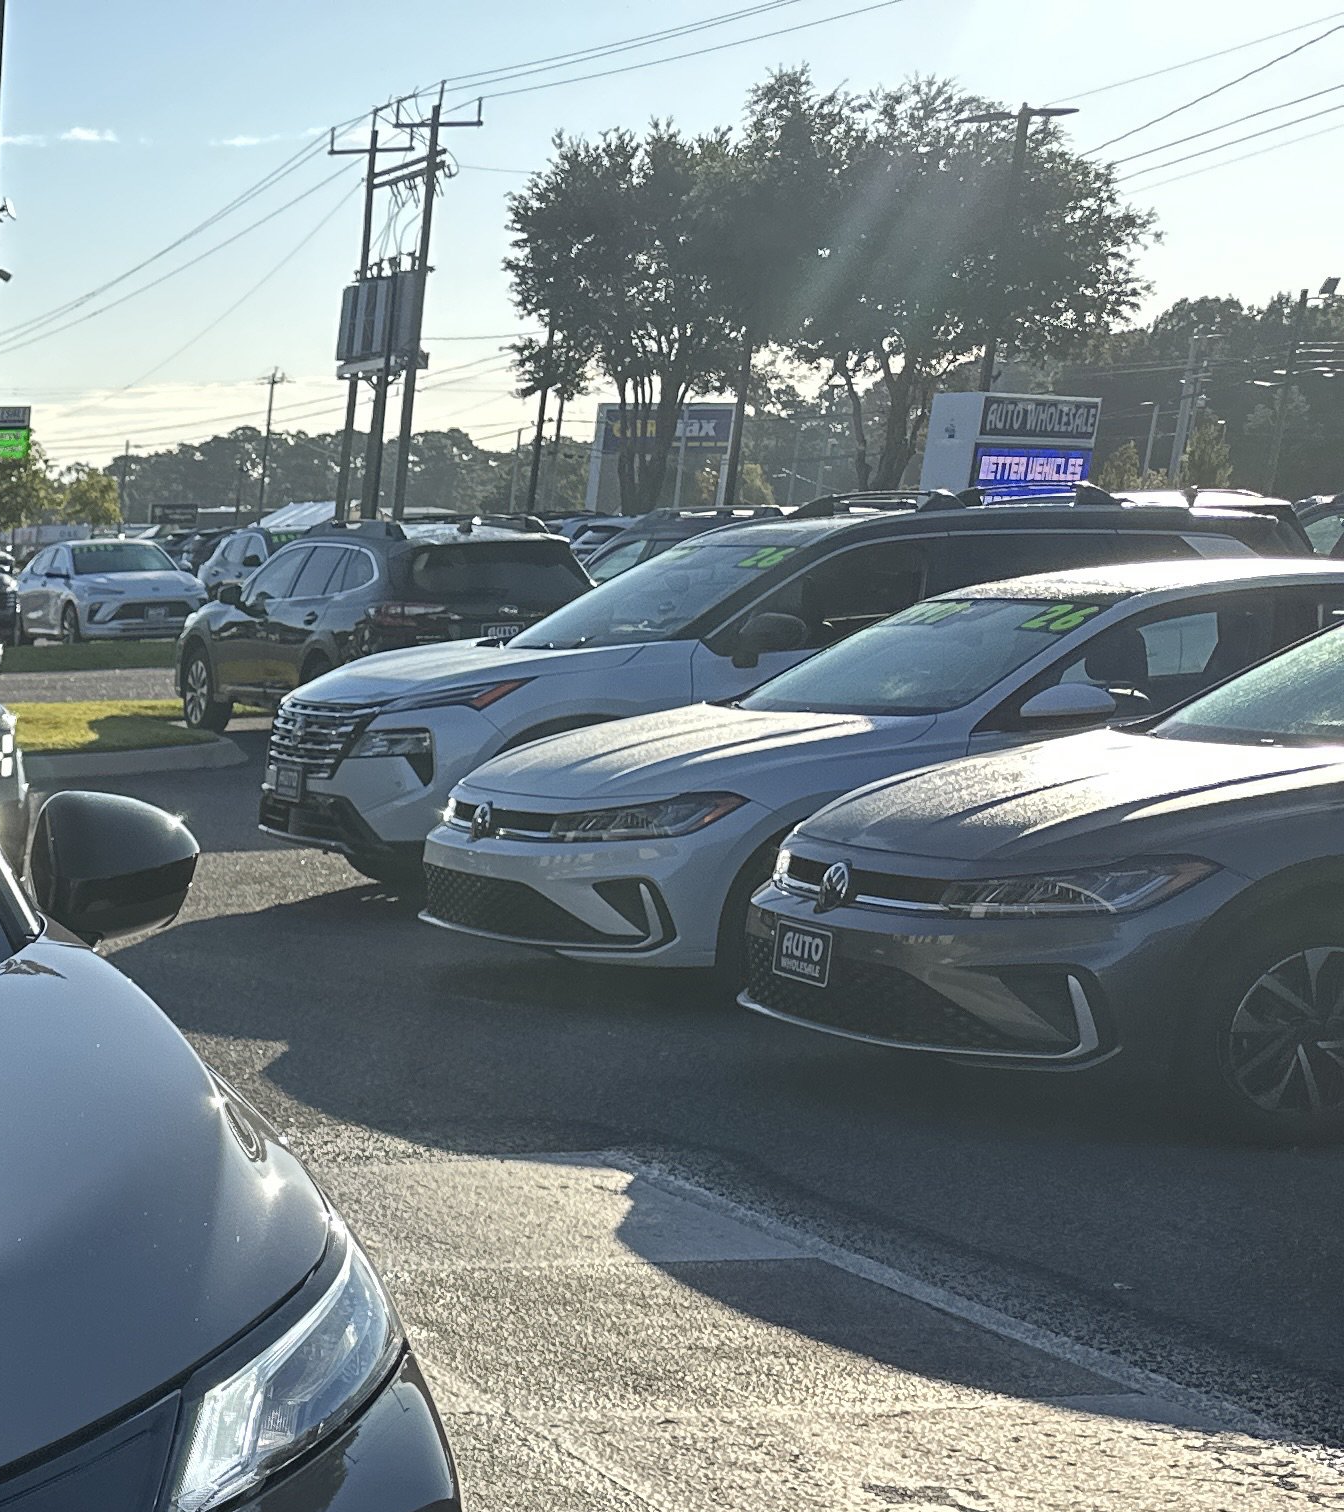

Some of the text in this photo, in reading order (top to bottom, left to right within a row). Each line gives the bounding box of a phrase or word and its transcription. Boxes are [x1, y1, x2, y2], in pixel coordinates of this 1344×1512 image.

[986, 402, 1096, 434] AUTO WHOLESALE
[1026, 457, 1084, 481] VEHICLES
[736, 546, 796, 568] 26
[1020, 604, 1100, 631] 26
[487, 625, 519, 638] AUTO
[782, 931, 824, 962] AUTO
[780, 956, 821, 978] WHOLESALE
